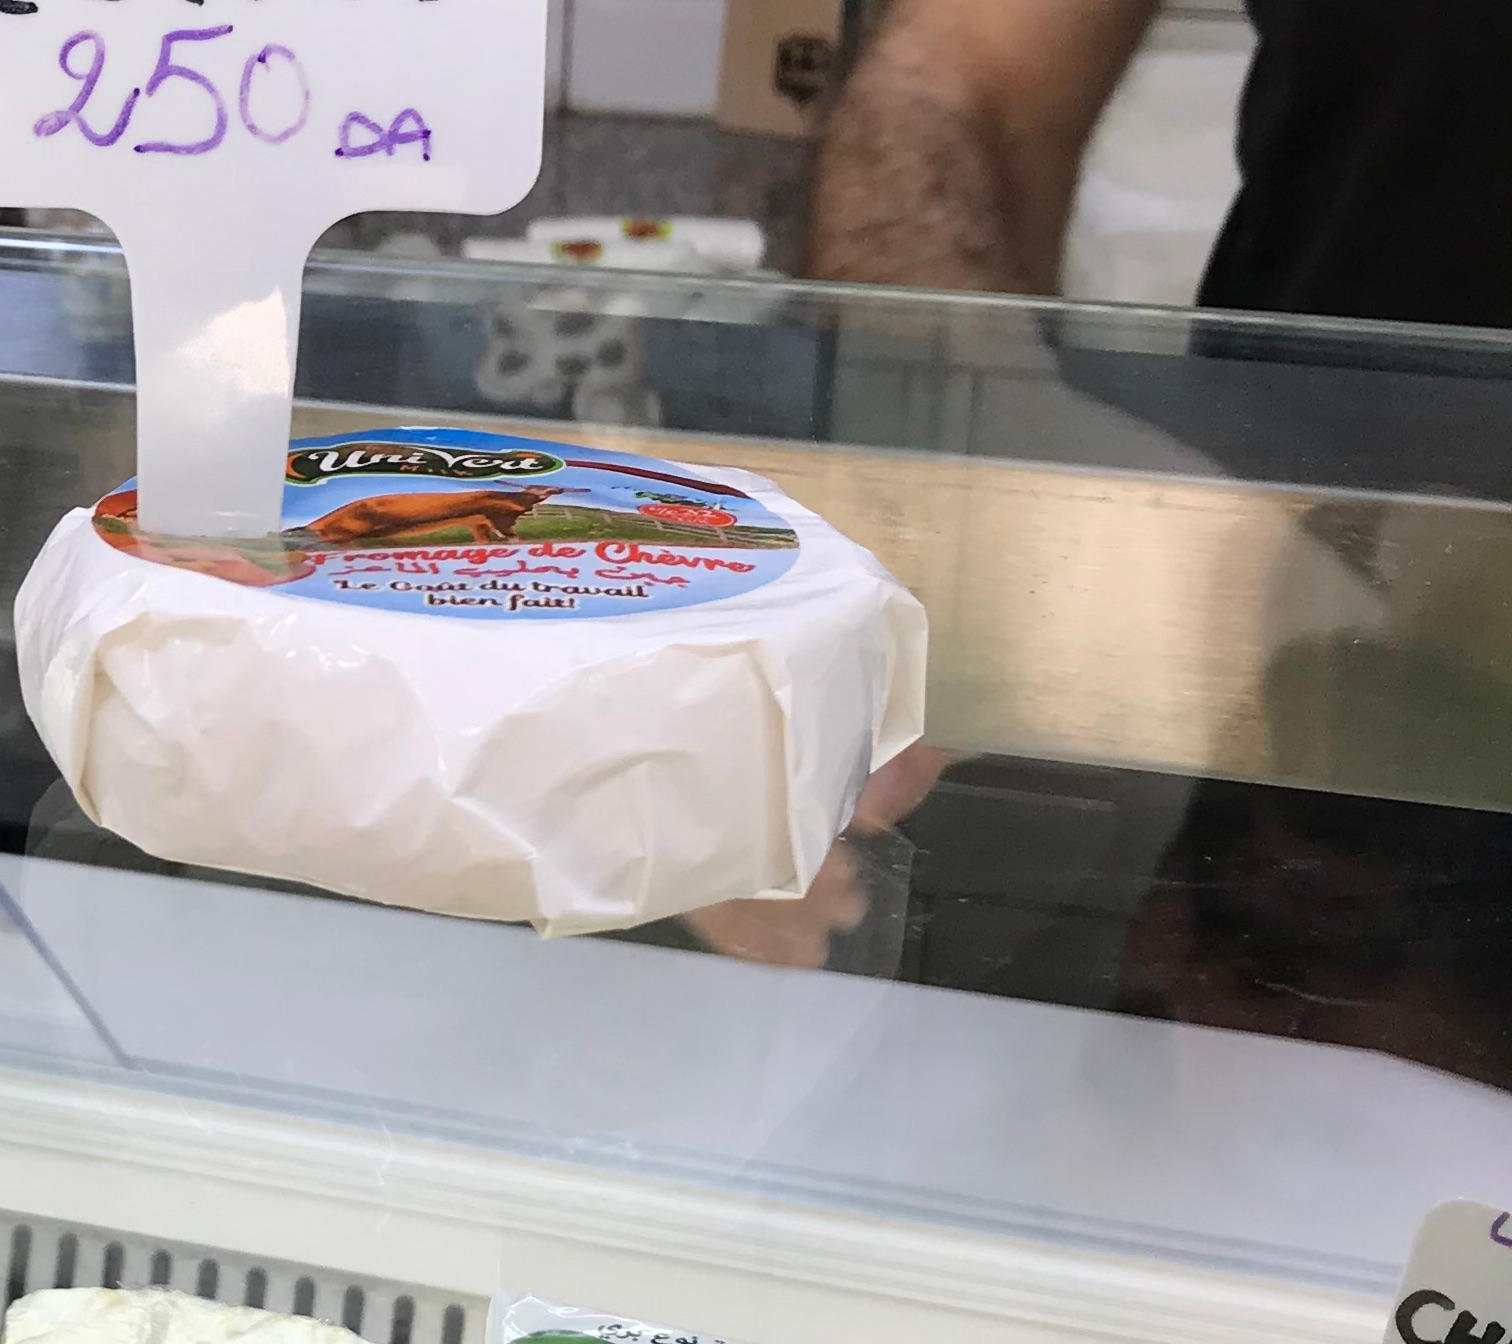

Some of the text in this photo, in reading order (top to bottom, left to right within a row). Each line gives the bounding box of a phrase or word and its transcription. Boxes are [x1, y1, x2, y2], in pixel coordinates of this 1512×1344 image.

[33, 24, 431, 161] 250 DA
[304, 541, 756, 573] Fromage de Chèvre
[333, 579, 377, 592] Le
[480, 579, 526, 592] du
[531, 582, 650, 599] travail
[428, 594, 502, 607] bien
